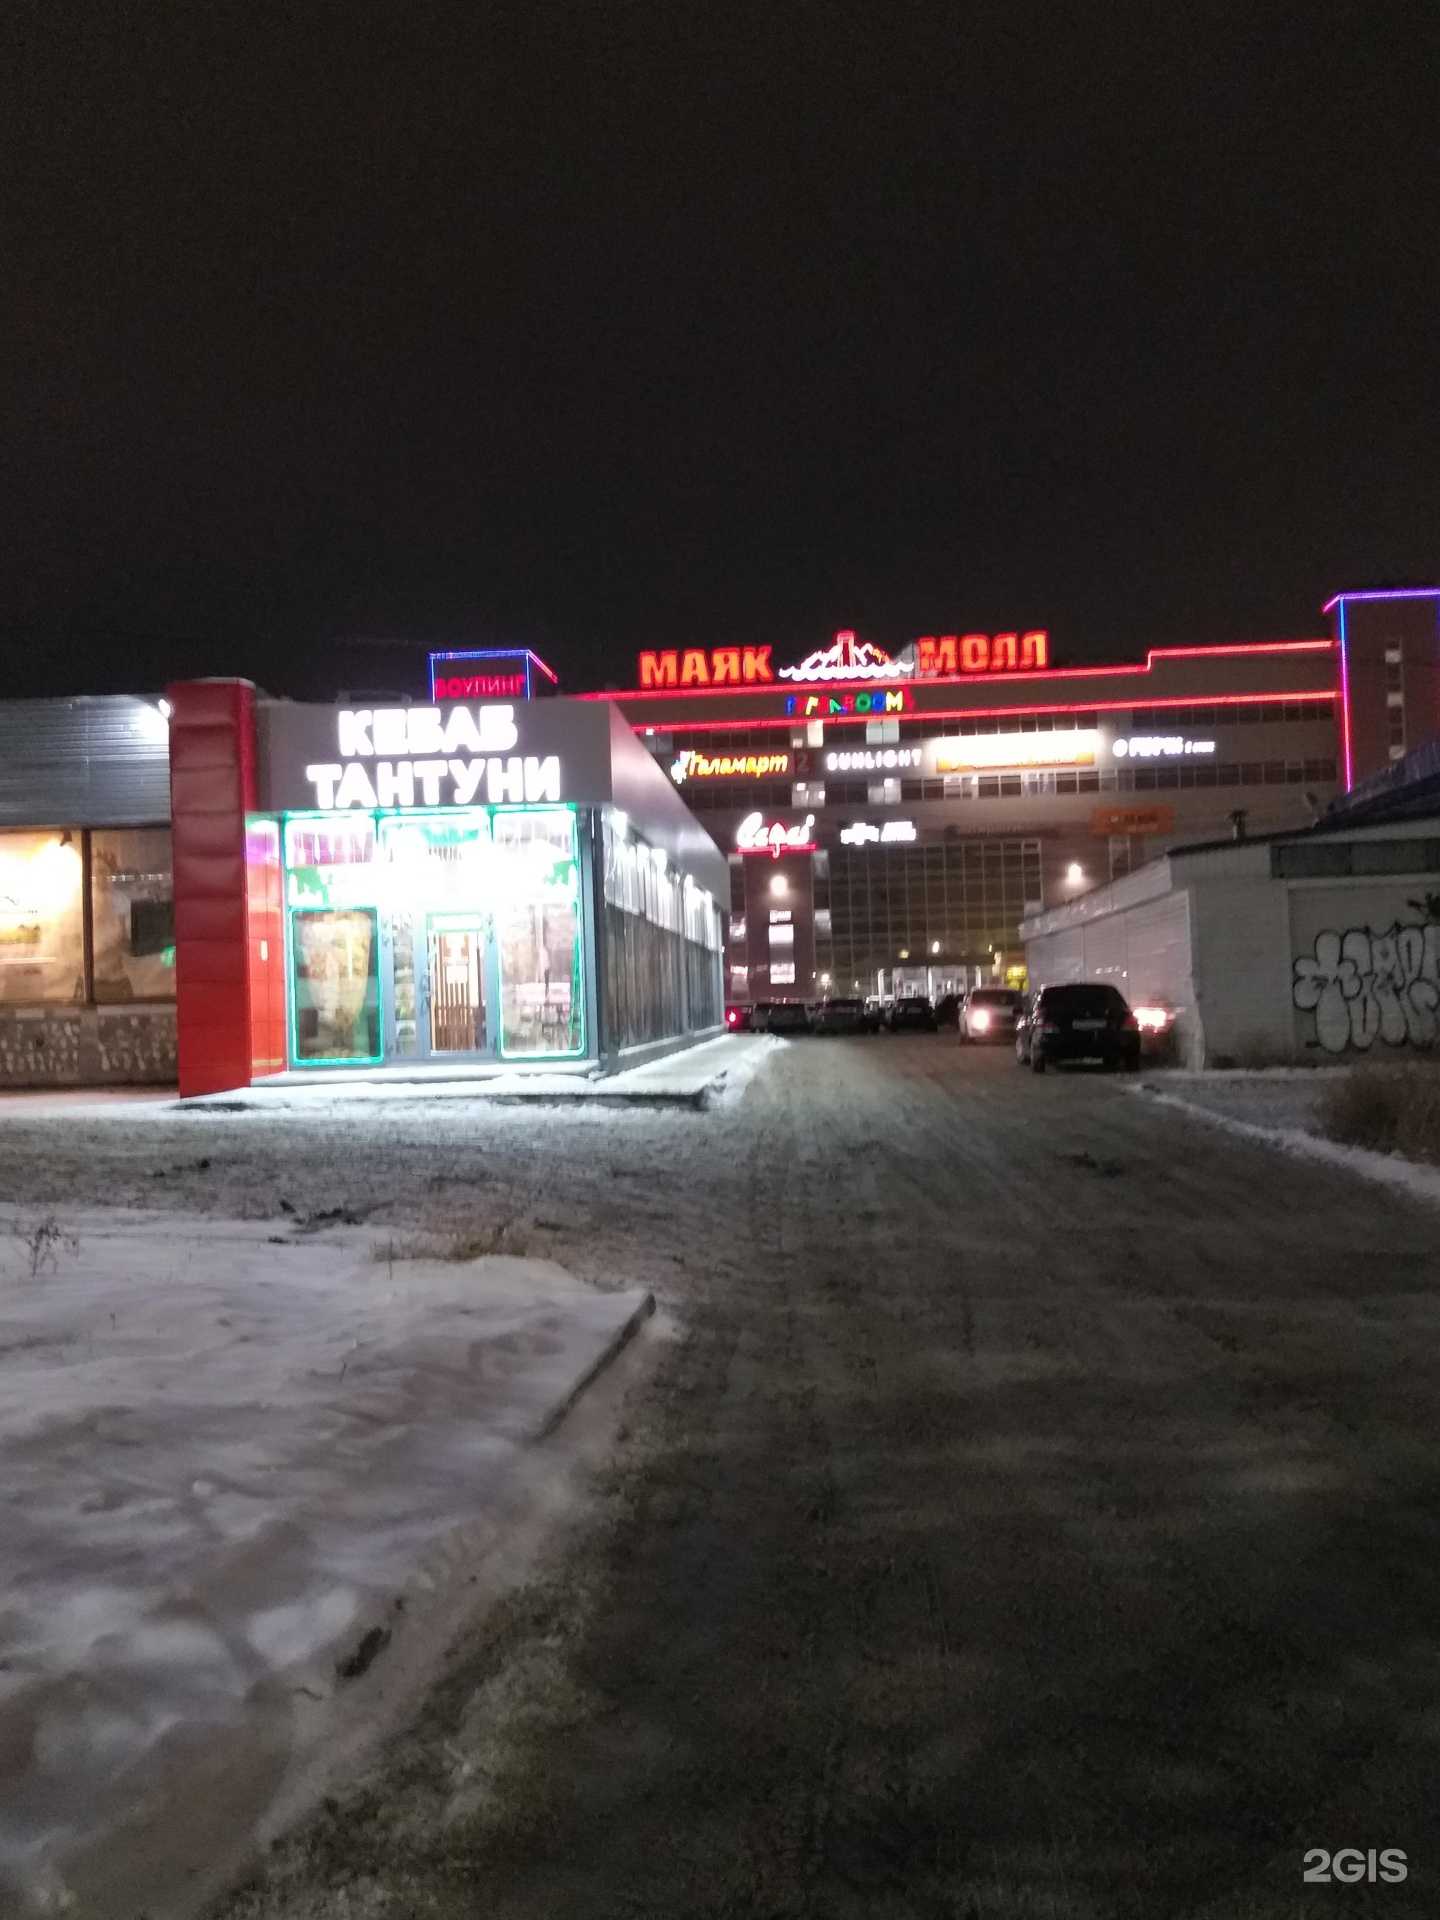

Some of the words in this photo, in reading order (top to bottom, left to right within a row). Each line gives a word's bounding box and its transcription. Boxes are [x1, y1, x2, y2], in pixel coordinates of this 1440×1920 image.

[639, 646, 772, 688] МАЯК
[918, 631, 1048, 672] МОЛЛ
[338, 704, 518, 756] КЕБАБ
[306, 756, 561, 809] ТАНТУНИ
